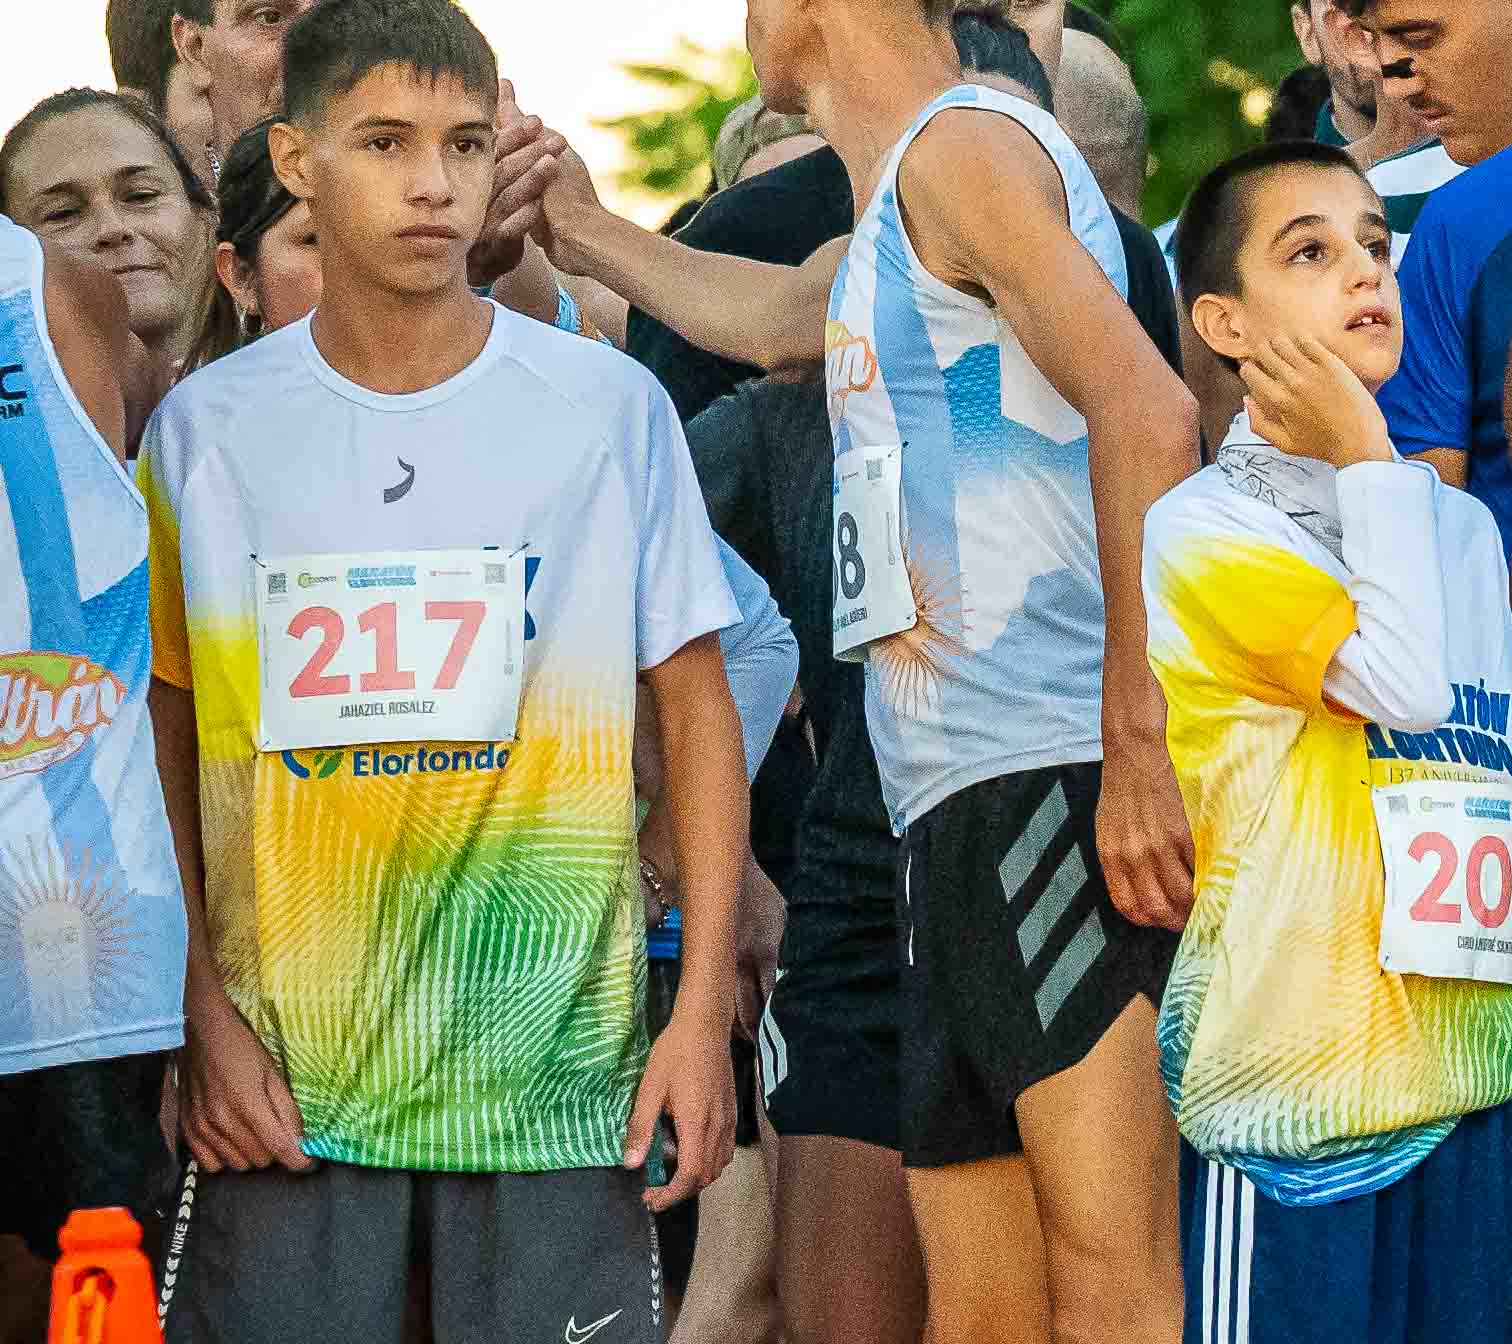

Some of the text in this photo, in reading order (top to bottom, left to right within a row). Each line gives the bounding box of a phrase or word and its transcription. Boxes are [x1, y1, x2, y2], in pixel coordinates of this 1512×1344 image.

[287, 600, 487, 698] 217
[338, 702, 386, 719] JAHAZIEL
[1450, 678, 1511, 736] ATÓN
[169, 1221, 188, 1255] NIKE
